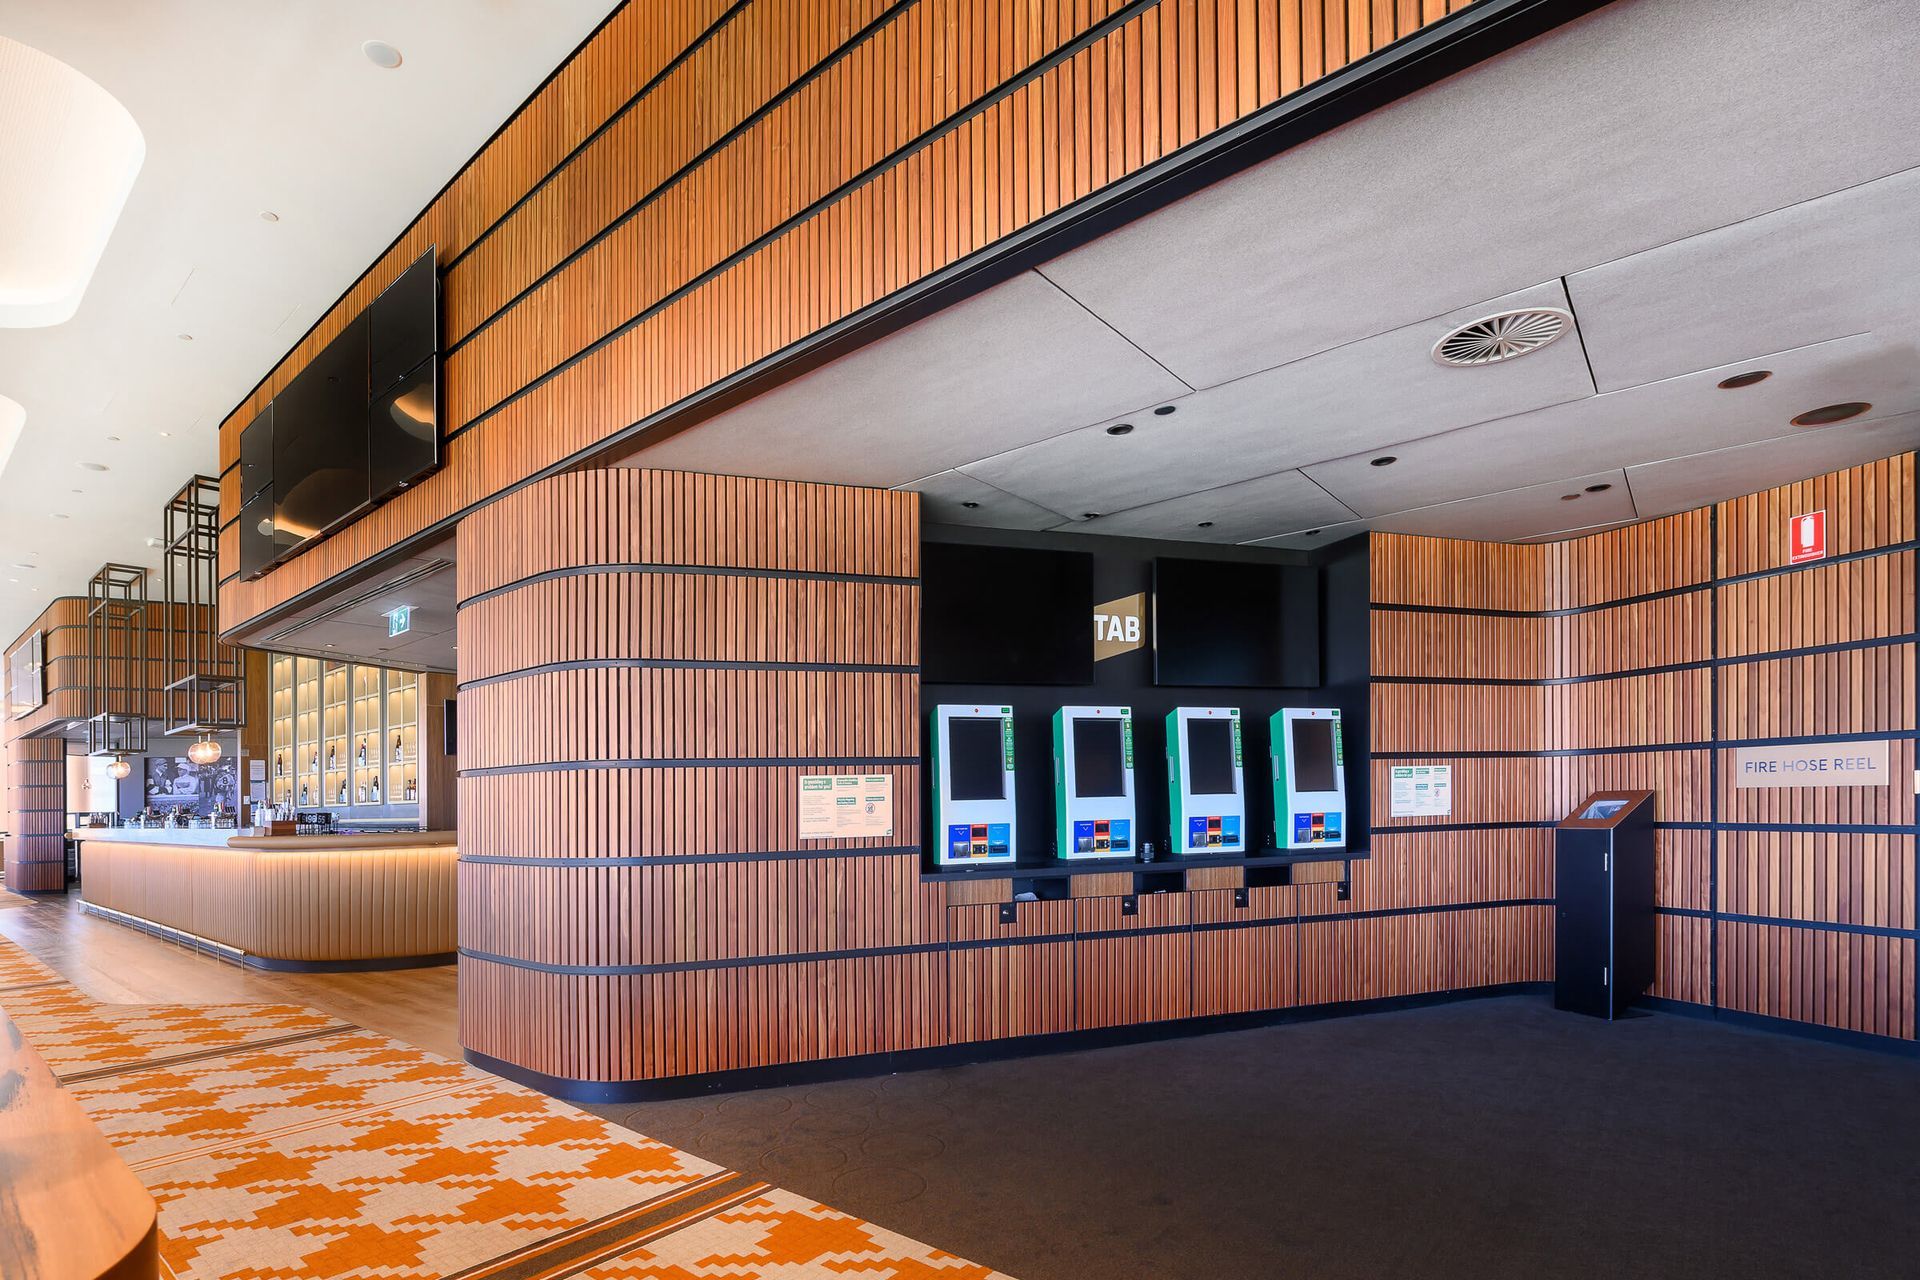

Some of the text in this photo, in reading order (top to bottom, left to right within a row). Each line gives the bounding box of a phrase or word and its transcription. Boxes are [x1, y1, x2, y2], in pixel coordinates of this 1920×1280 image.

[1093, 614, 1140, 643] TAB
[1745, 757, 1876, 773] FIRE HOSE REEL
